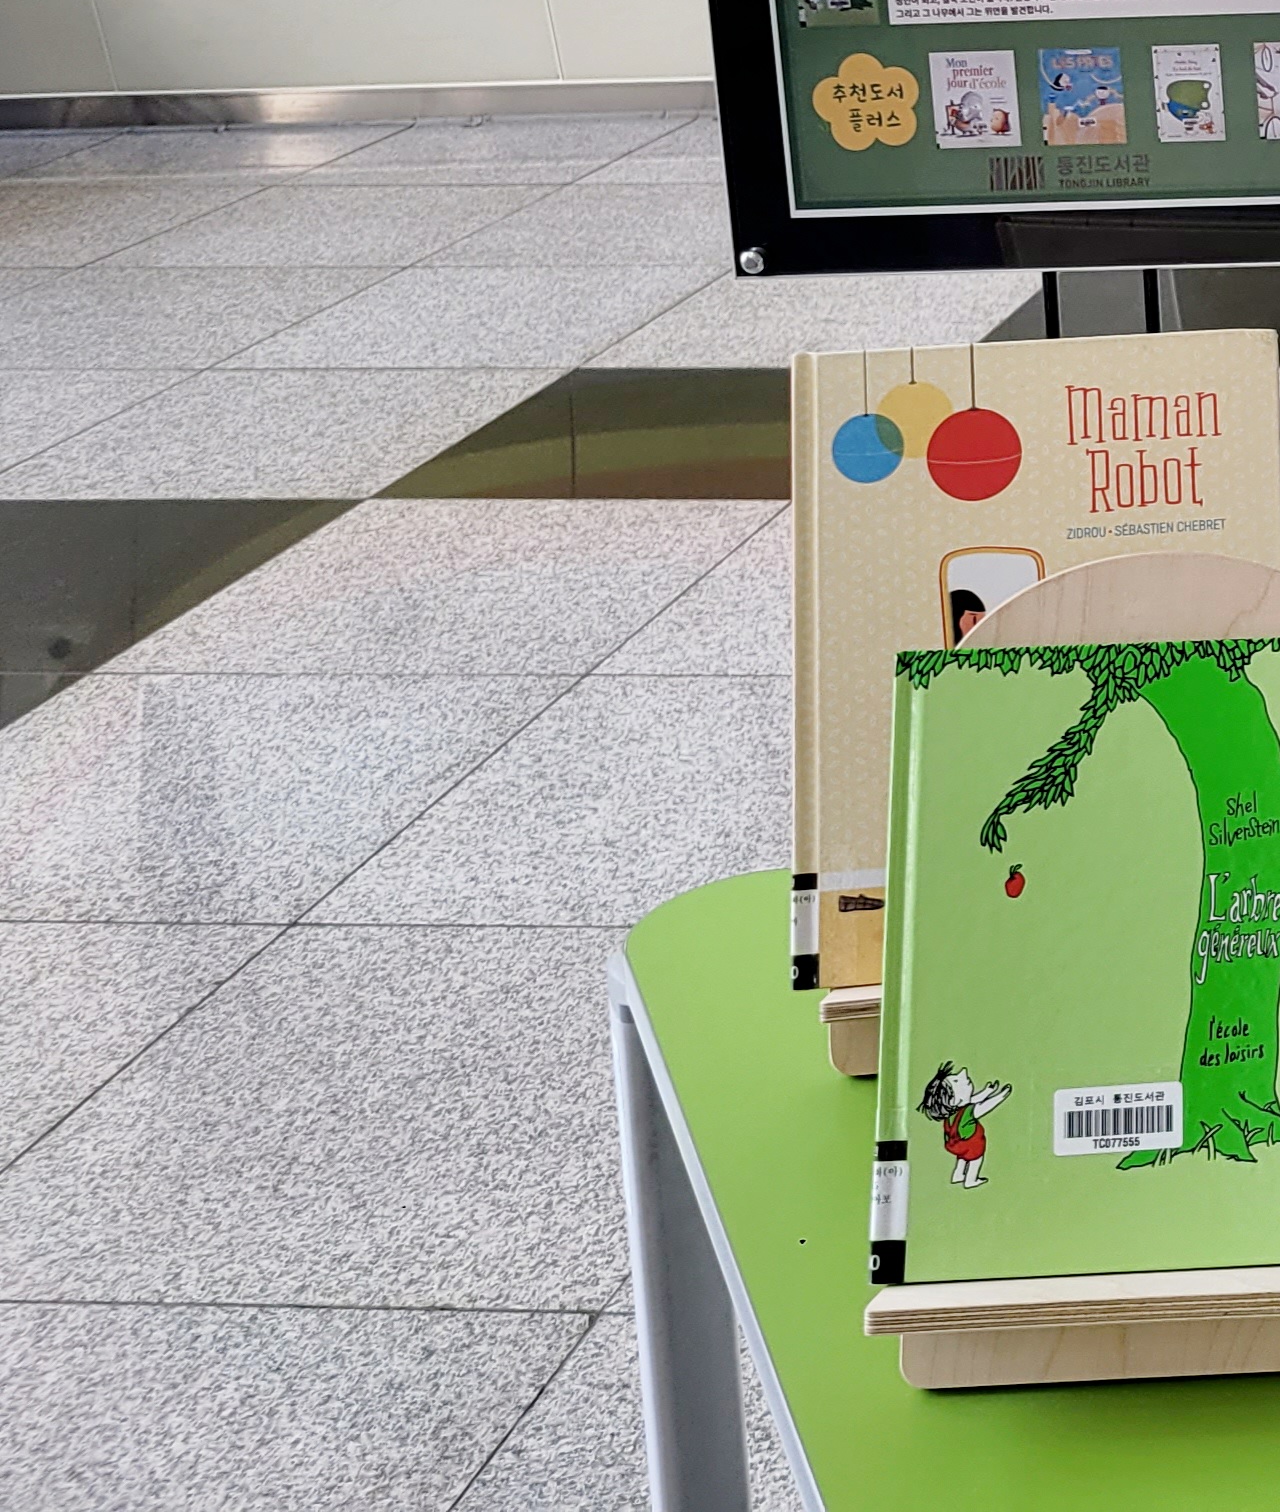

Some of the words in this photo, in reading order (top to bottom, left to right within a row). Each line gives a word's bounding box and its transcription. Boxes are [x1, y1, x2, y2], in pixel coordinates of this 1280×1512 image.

[945, 58, 967, 68] Mon
[952, 66, 994, 78] premier
[832, 83, 904, 104] 추천도서
[947, 77, 968, 90] jour
[849, 109, 901, 133] 플러스
[1056, 156, 1150, 174] 통진도서관
[1065, 385, 1222, 445] Maman
[1086, 447, 1204, 514] Robot
[1067, 527, 1107, 540] ZIDROU
[1115, 521, 1174, 537] SÉBASTIEN
[1177, 519, 1226, 533] CHEBRET
[1227, 791, 1258, 816] Shel
[1209, 1016, 1250, 1040] l'école
[1200, 1049, 1223, 1068] des
[1224, 1042, 1265, 1065] loisirs
[1073, 1091, 1105, 1107] 김포시
[1113, 1089, 1165, 1105] 통진도서관
[1092, 1136, 1140, 1150] TC077555
